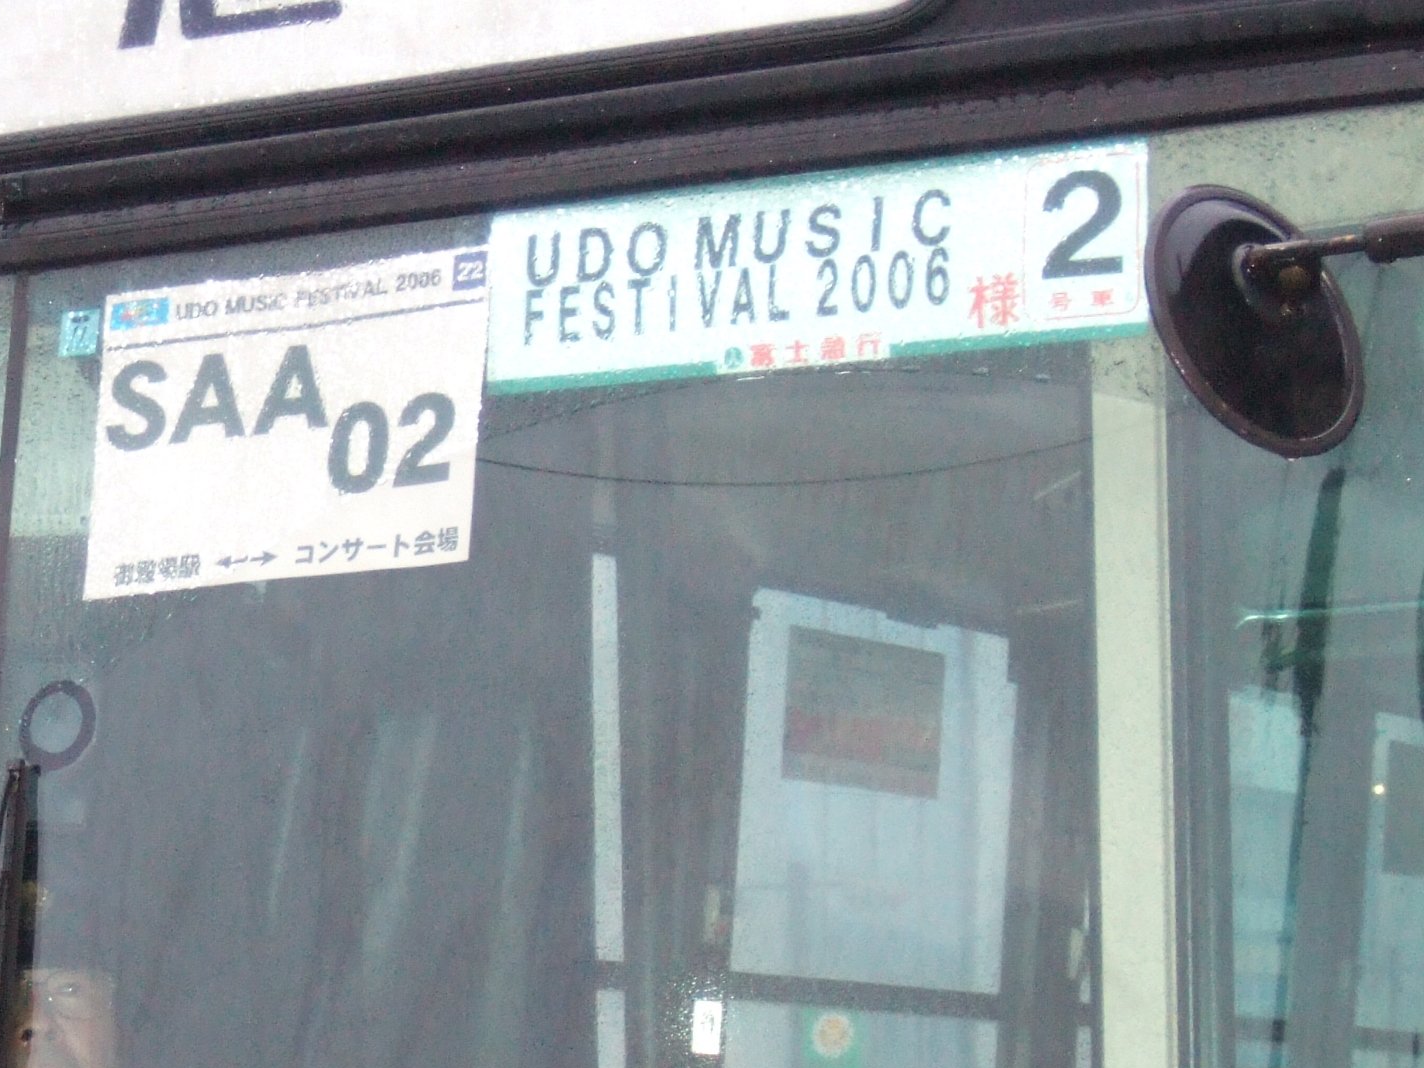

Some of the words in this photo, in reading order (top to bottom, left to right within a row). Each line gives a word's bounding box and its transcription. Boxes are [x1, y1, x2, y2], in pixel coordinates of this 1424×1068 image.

[527, 222, 668, 287] UDO
[694, 189, 952, 270] MUSIC
[1041, 170, 1123, 279] 2
[176, 299, 218, 320] UDO
[225, 294, 285, 315] MUSIC
[296, 279, 388, 309] FESTIVAL
[396, 269, 442, 291] 2006
[457, 260, 484, 281] 22
[524, 265, 789, 345] FESTIVAL
[816, 247, 950, 316] 2006
[968, 272, 1020, 328] 様
[106, 344, 329, 452] SAA
[327, 391, 457, 496] 02
[295, 527, 460, 566] コンサート会場
